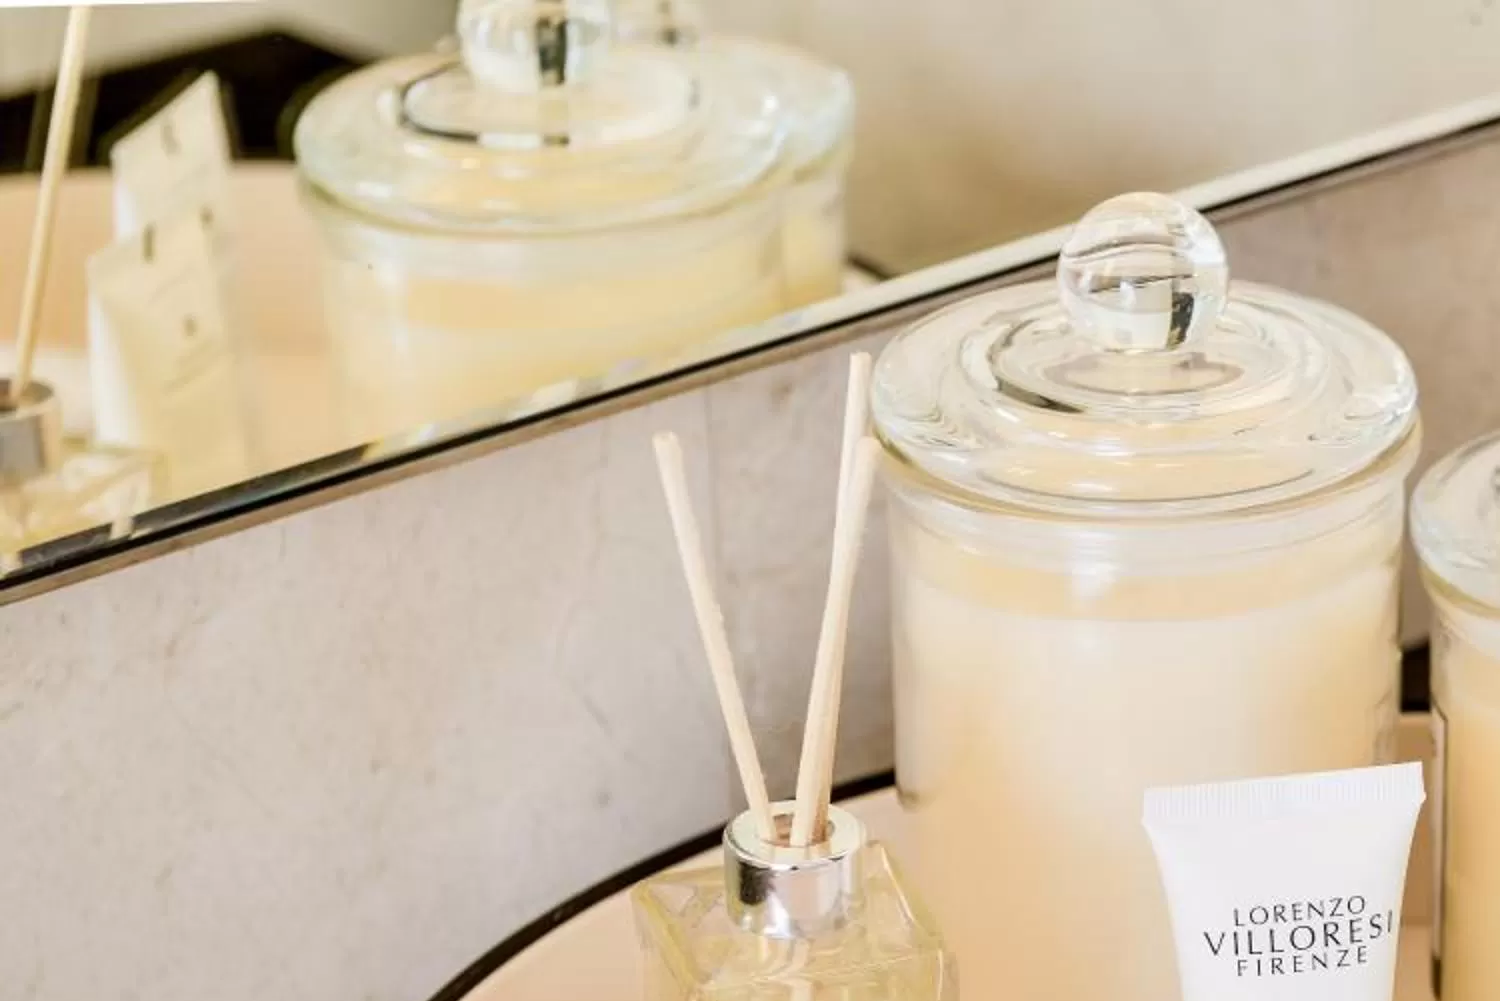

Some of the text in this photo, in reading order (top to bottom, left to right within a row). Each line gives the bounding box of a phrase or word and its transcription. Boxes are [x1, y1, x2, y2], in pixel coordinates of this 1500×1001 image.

[1233, 895, 1366, 927] LORENZO
[1203, 909, 1394, 957] VILLORESI
[1237, 946, 1368, 977] FIRENZE
